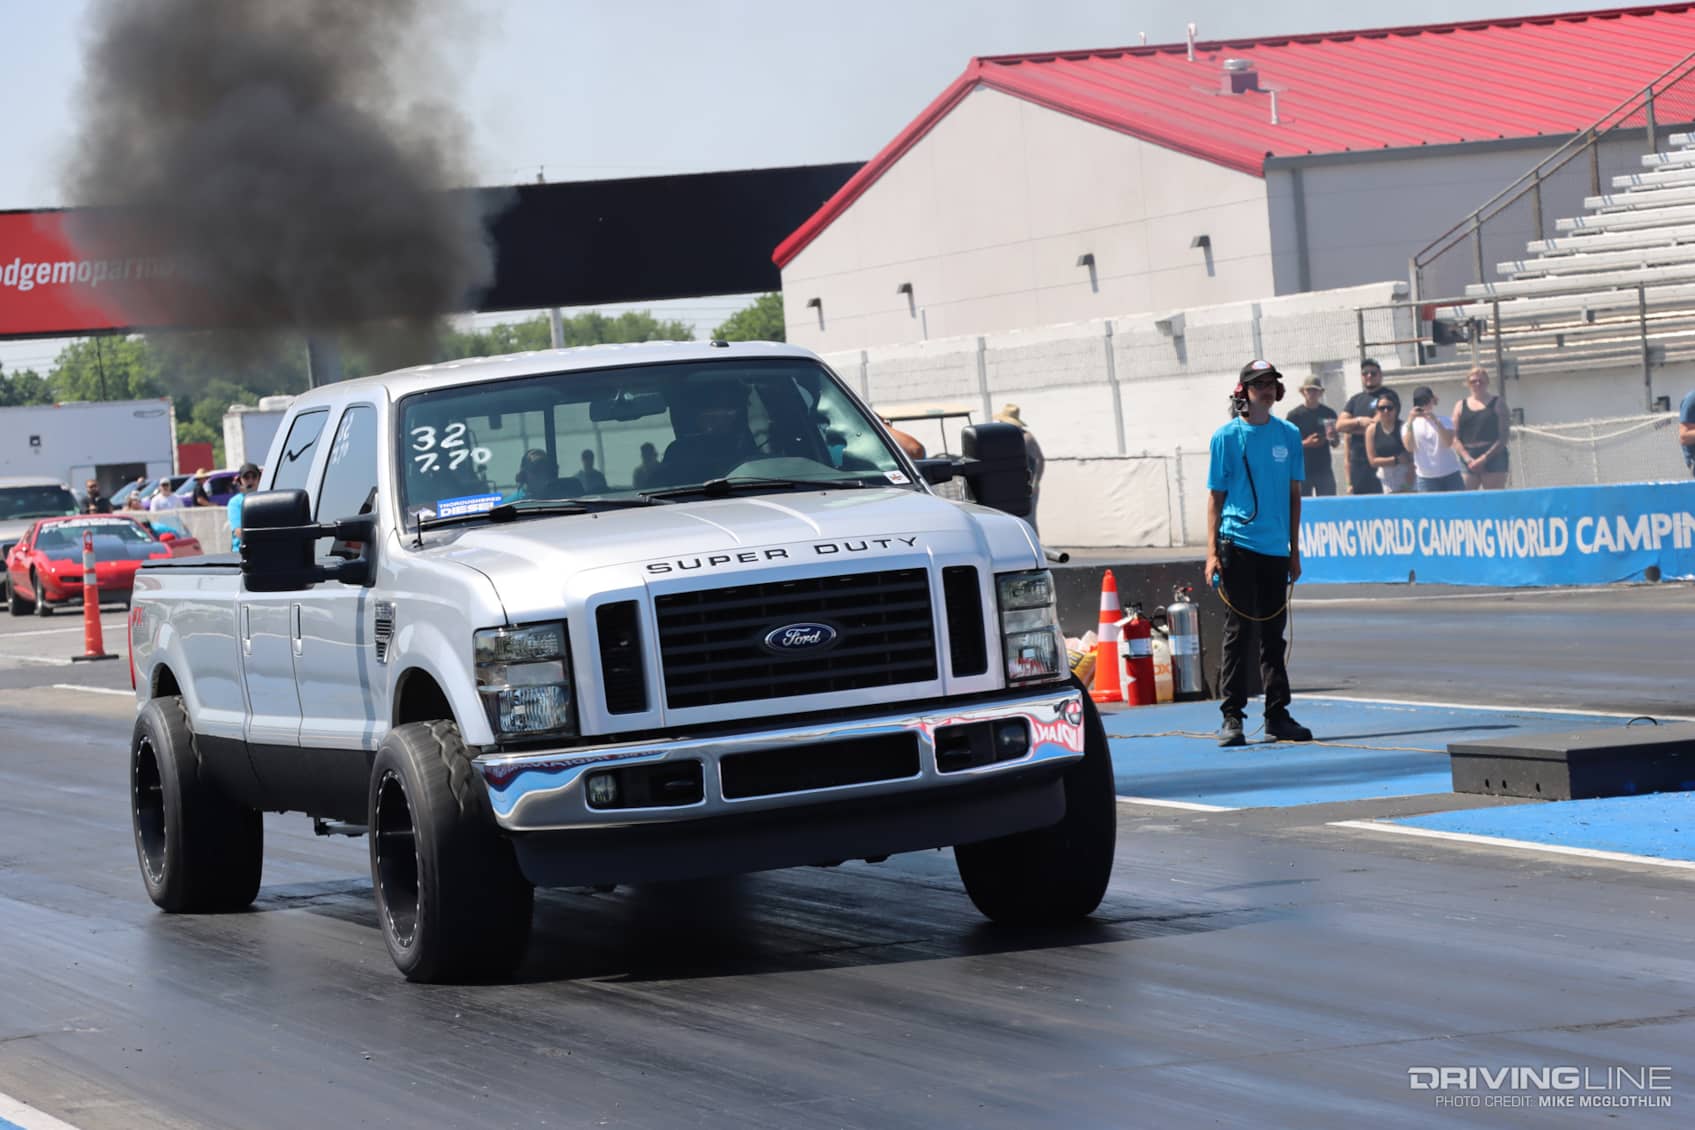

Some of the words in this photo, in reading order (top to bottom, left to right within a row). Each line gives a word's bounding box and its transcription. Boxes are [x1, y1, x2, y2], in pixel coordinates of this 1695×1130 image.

[411, 423, 466, 451] 32
[414, 447, 493, 473] 7.70
[1298, 519, 1357, 557] AMPING
[1356, 518, 1415, 556] WORLD
[1418, 518, 1496, 558] CAMPING
[1495, 517, 1569, 558] WORLD
[646, 548, 789, 574] SUPER
[813, 536, 917, 555] DUTY
[782, 627, 821, 647] Ford
